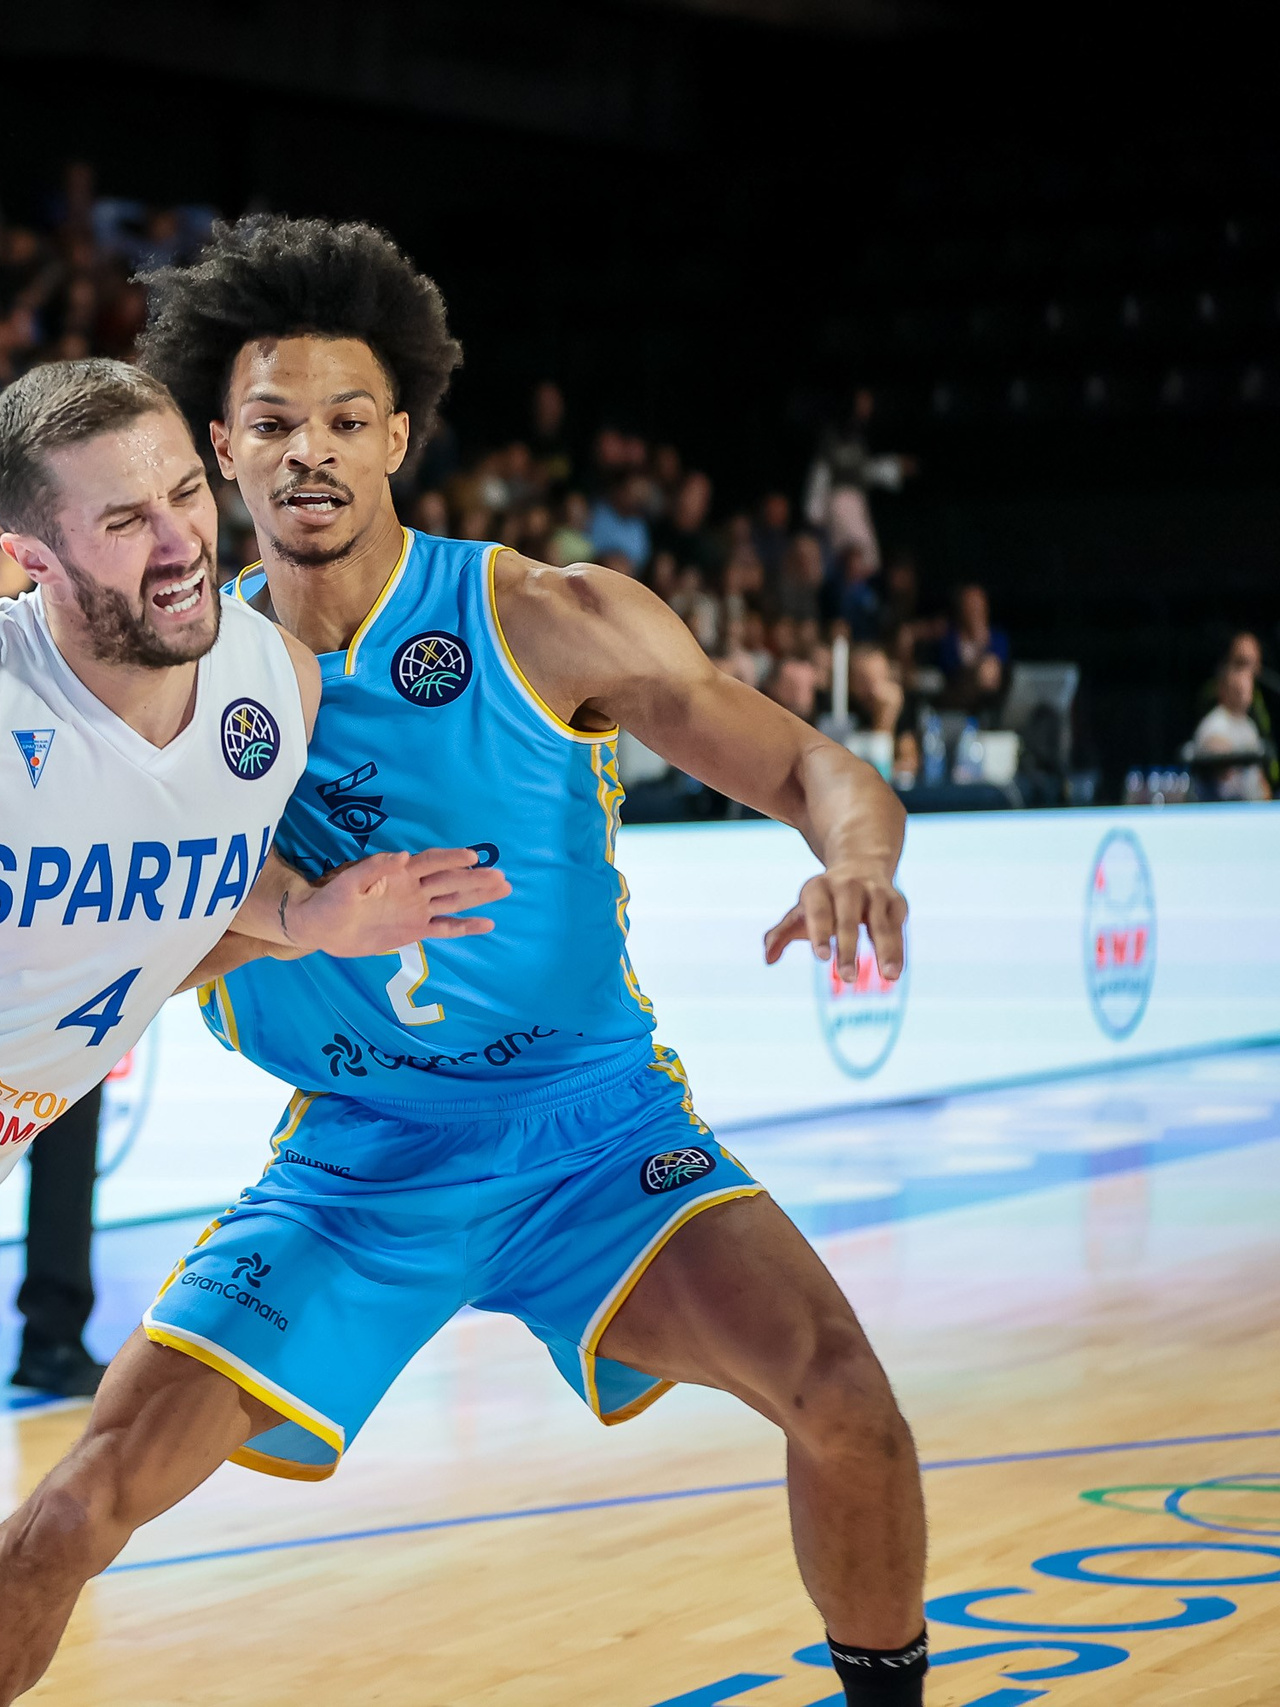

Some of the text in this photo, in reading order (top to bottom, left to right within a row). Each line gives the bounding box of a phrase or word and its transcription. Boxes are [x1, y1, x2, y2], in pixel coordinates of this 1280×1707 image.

[56, 967, 142, 1047] 4
[377, 941, 445, 1026] 2
[182, 1272, 289, 1332] GranCanaria
